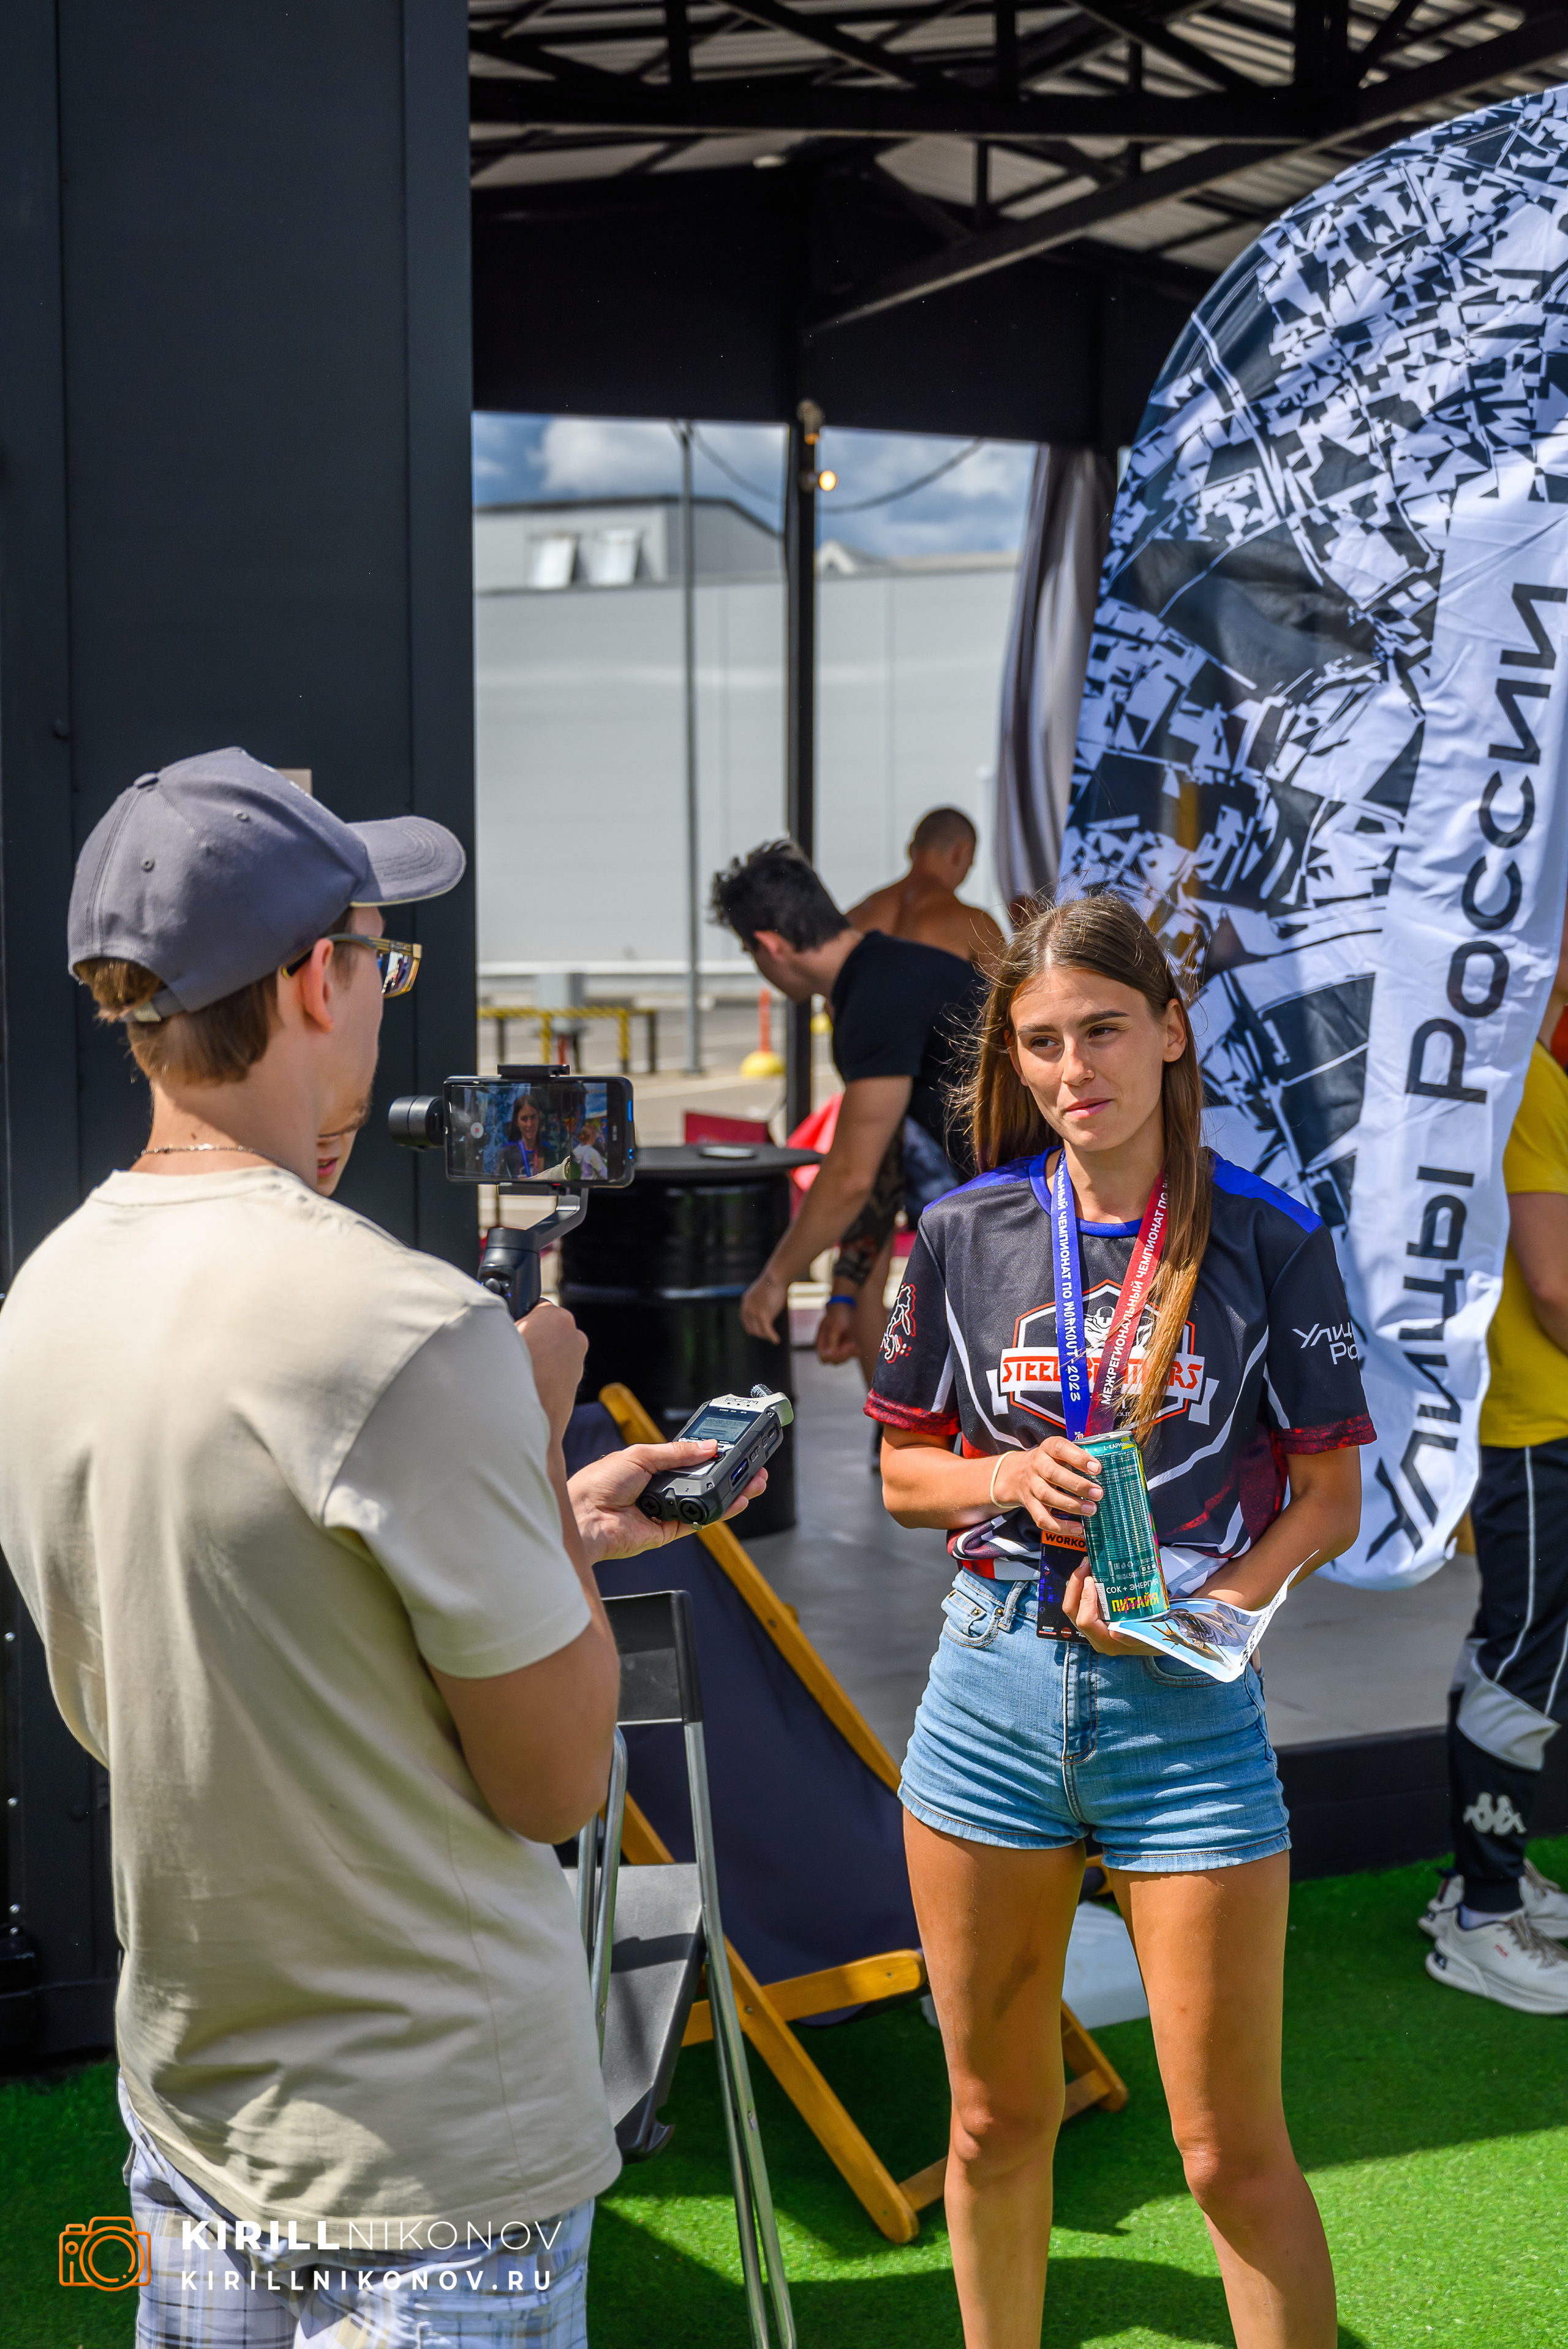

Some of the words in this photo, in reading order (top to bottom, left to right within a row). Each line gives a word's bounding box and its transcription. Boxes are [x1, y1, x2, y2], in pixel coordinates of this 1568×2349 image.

[1404, 581, 1568, 1105] России
[1058, 1211, 1071, 1280] ЧЕМПИОНАТ
[1061, 1282, 1072, 1298] ПО
[1100, 1280, 1144, 1405] МЕЖРЕГИОНАЛЬНЫЙ
[1136, 1209, 1165, 1279] ЧЕМПИОНАТ
[1158, 1192, 1169, 1209] ПО
[1062, 1301, 1081, 1402] WORKOUT-2023
[1365, 1165, 1475, 1562] Улицы
[1111, 1591, 1159, 1613] ПИТАЙЯ
[1129, 1578, 1159, 1591] ЭНЕРГИЯ
